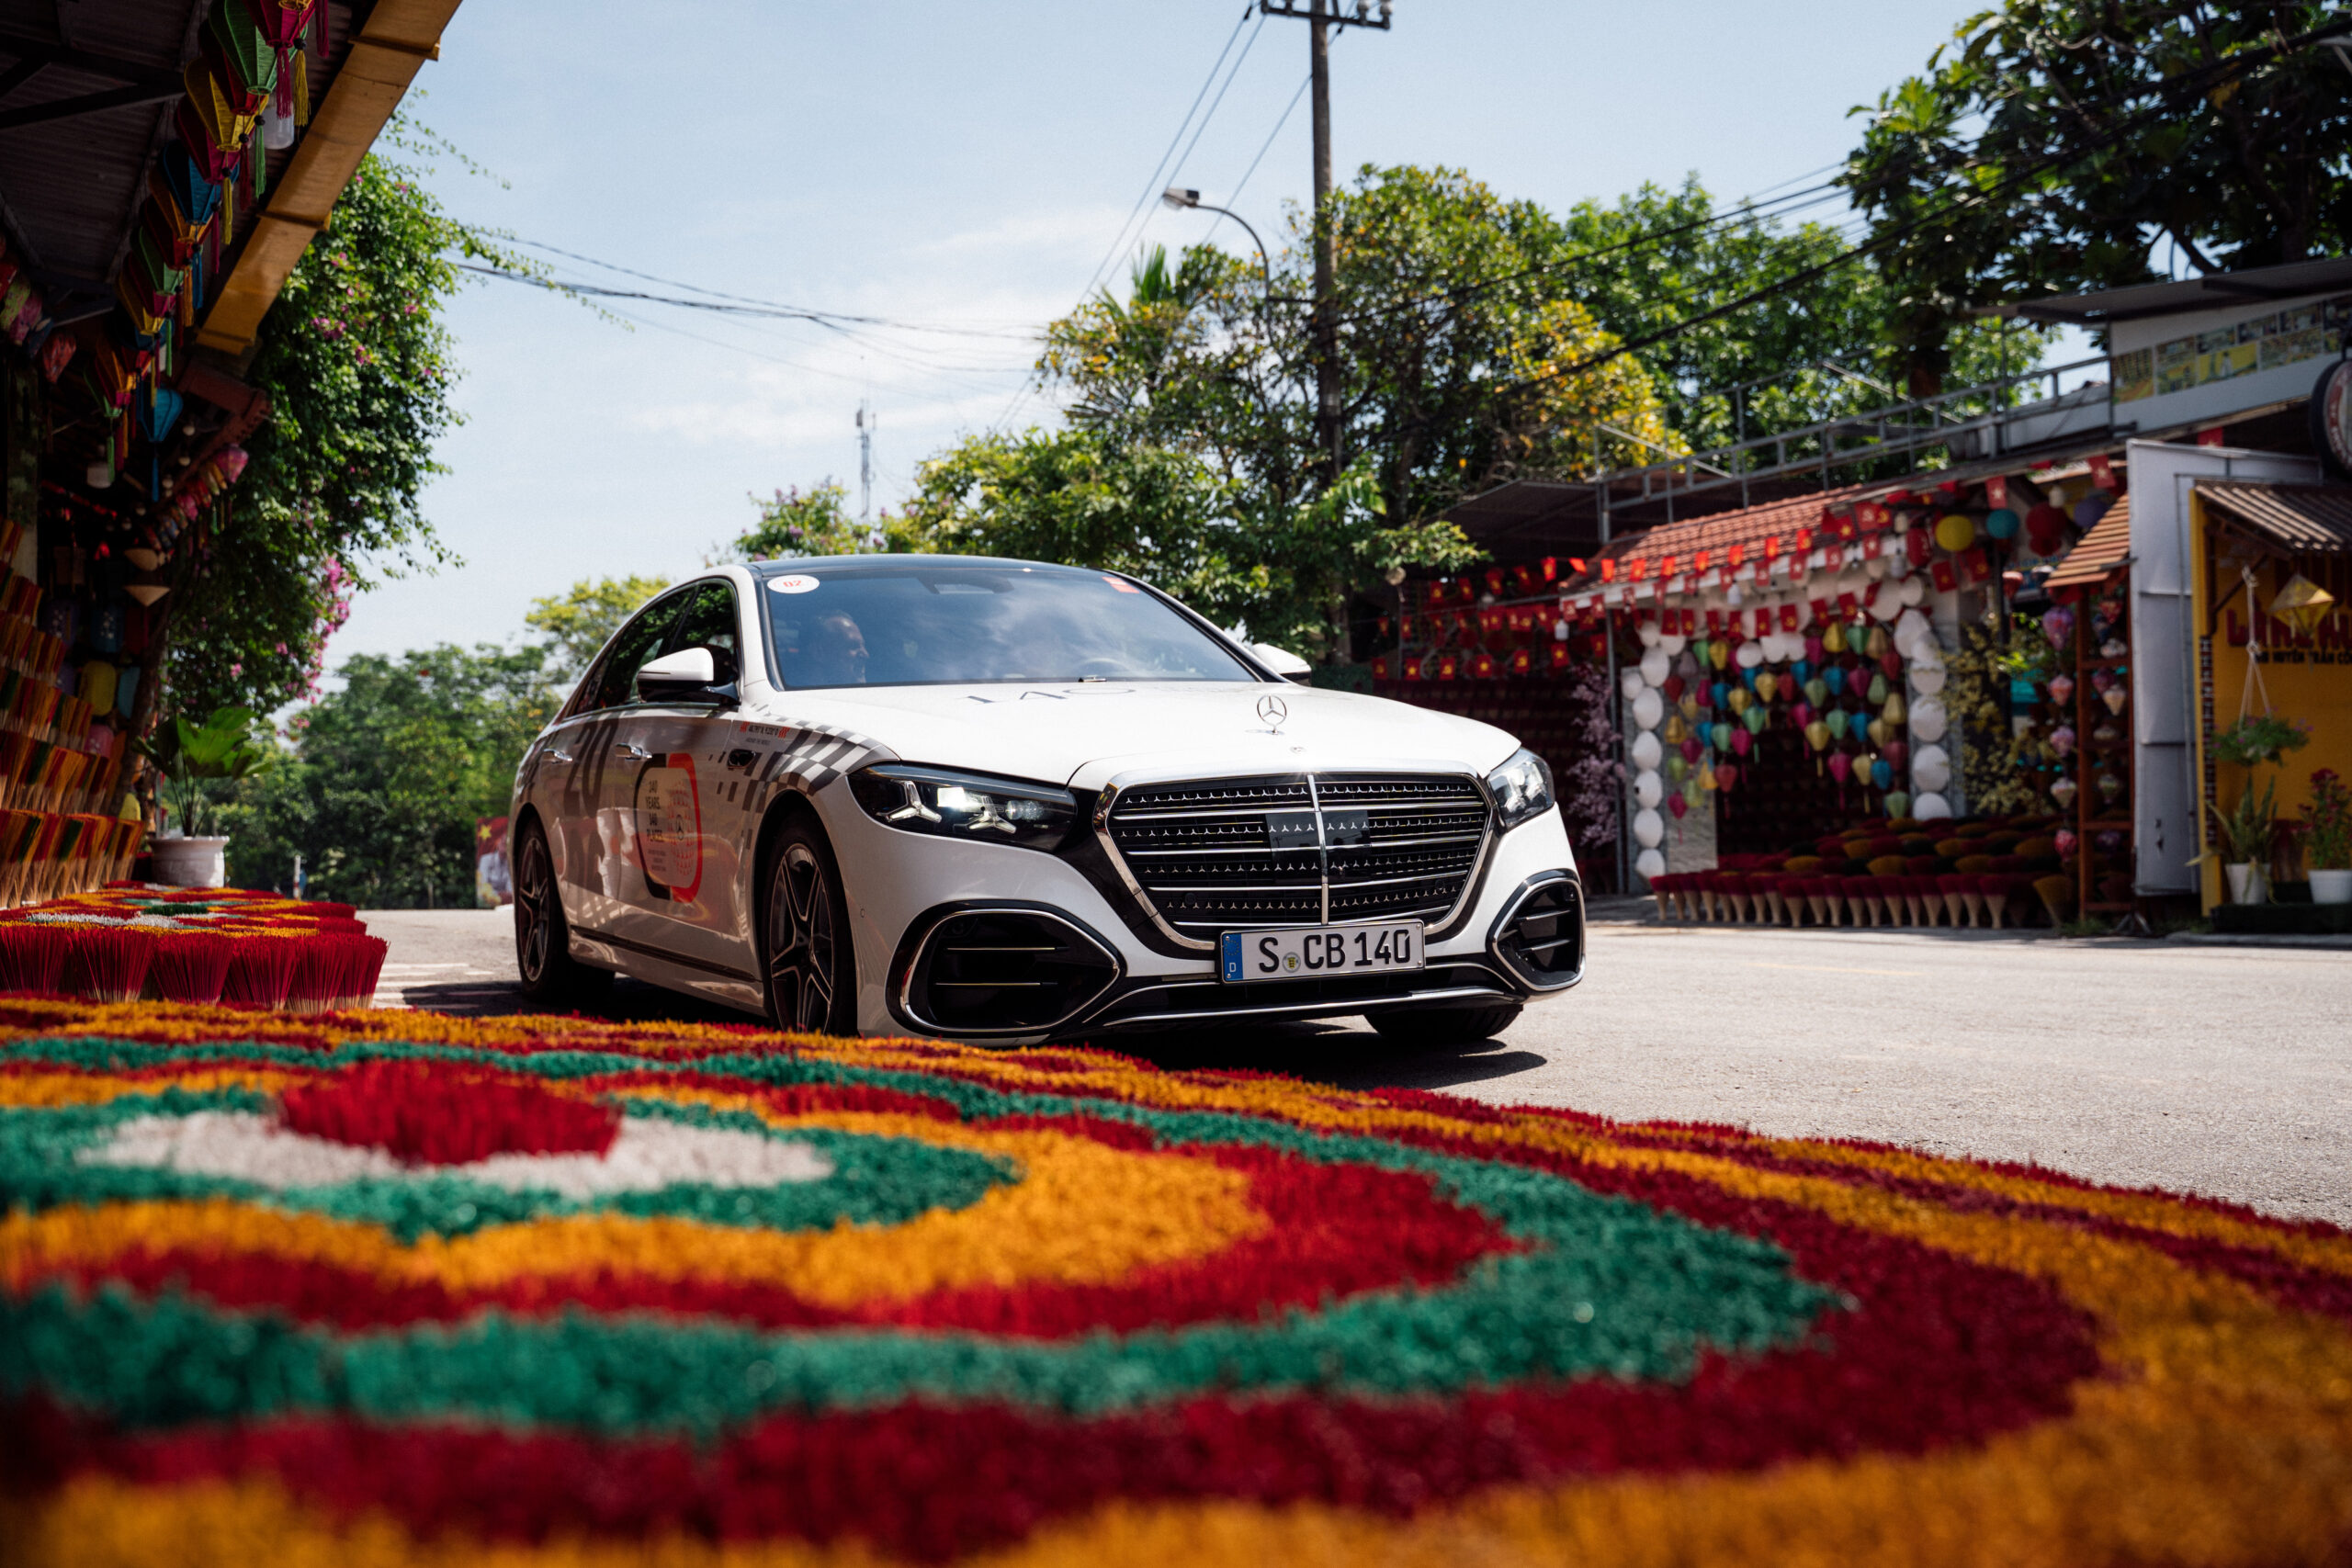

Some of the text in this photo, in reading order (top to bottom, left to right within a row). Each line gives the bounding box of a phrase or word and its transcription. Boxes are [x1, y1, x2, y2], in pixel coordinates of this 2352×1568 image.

[1258, 929, 1411, 974] S CB 140
[1228, 962, 1237, 973] D
